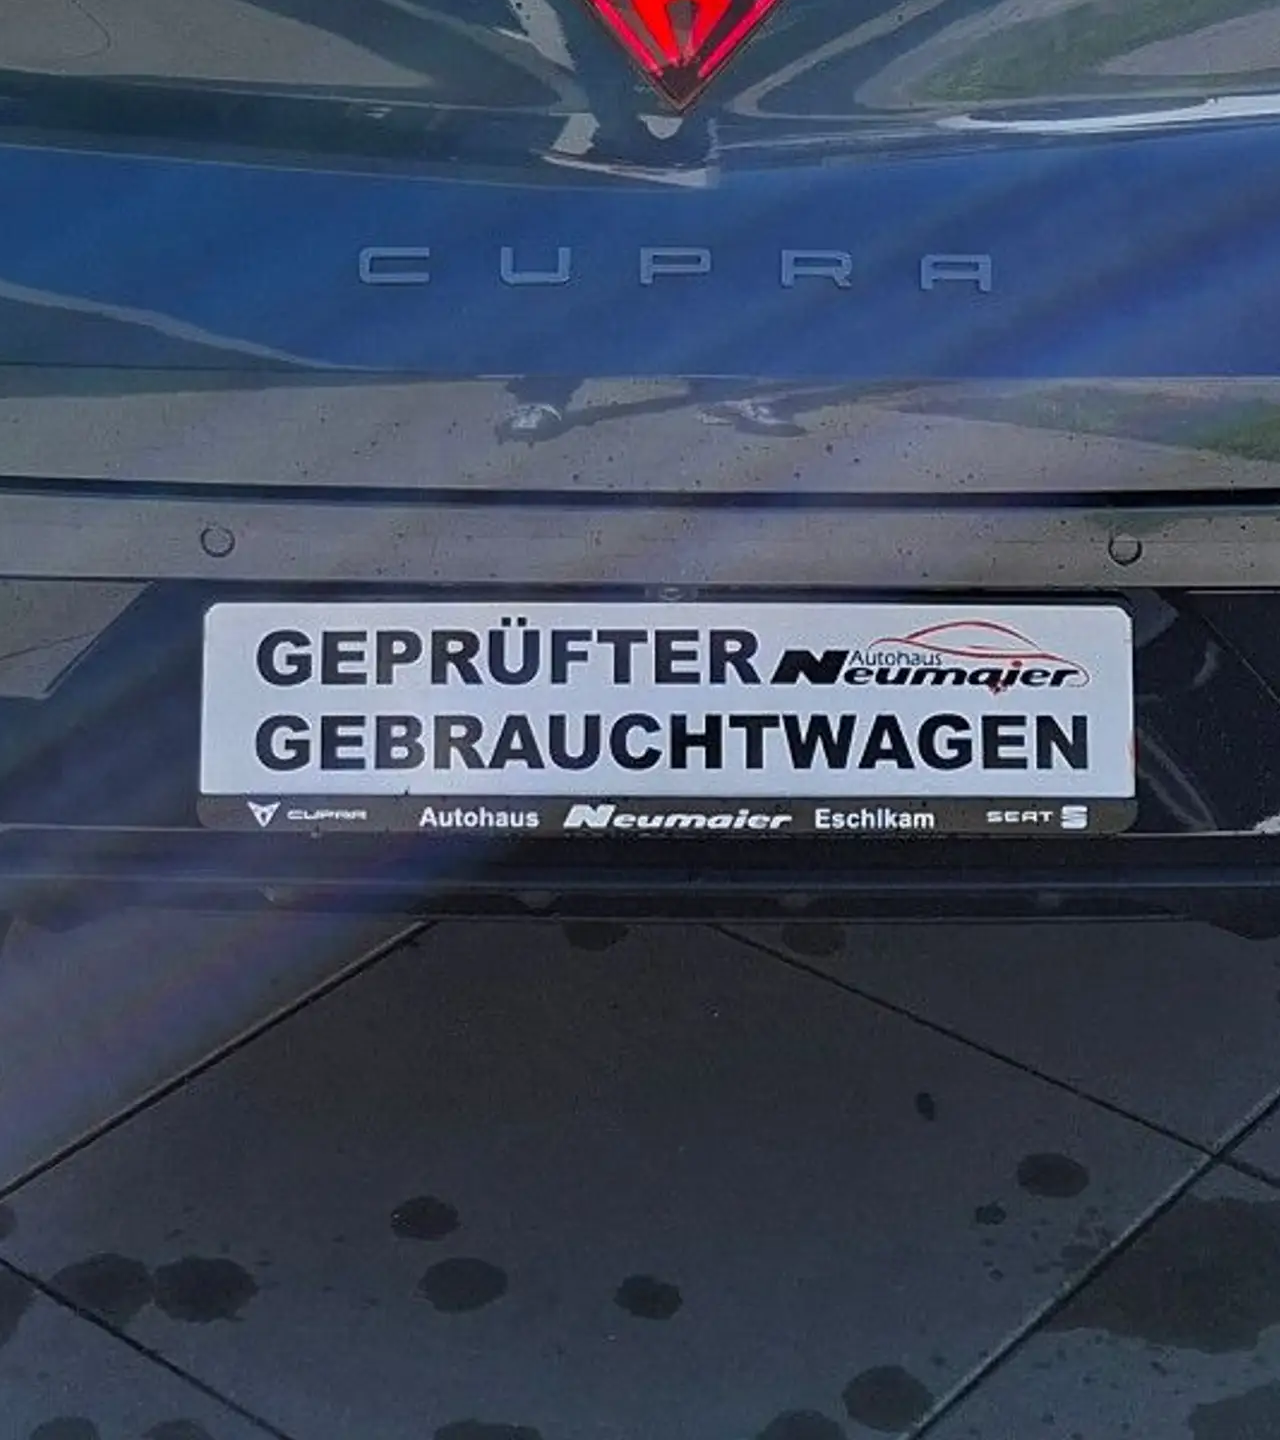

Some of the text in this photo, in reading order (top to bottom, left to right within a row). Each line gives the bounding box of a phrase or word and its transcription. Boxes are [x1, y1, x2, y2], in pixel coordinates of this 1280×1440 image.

[359, 247, 993, 291] CUPRA
[256, 617, 759, 686] GEPRÜFTER
[849, 651, 942, 667] Autohaus
[771, 650, 1080, 688] Neumaier
[255, 714, 1089, 771] GEBRAUCHTWAGEN
[287, 809, 367, 820] CUPRA
[420, 804, 935, 831] Autohaus Neumaier Eschlkam
[987, 811, 1054, 823] SEAT
